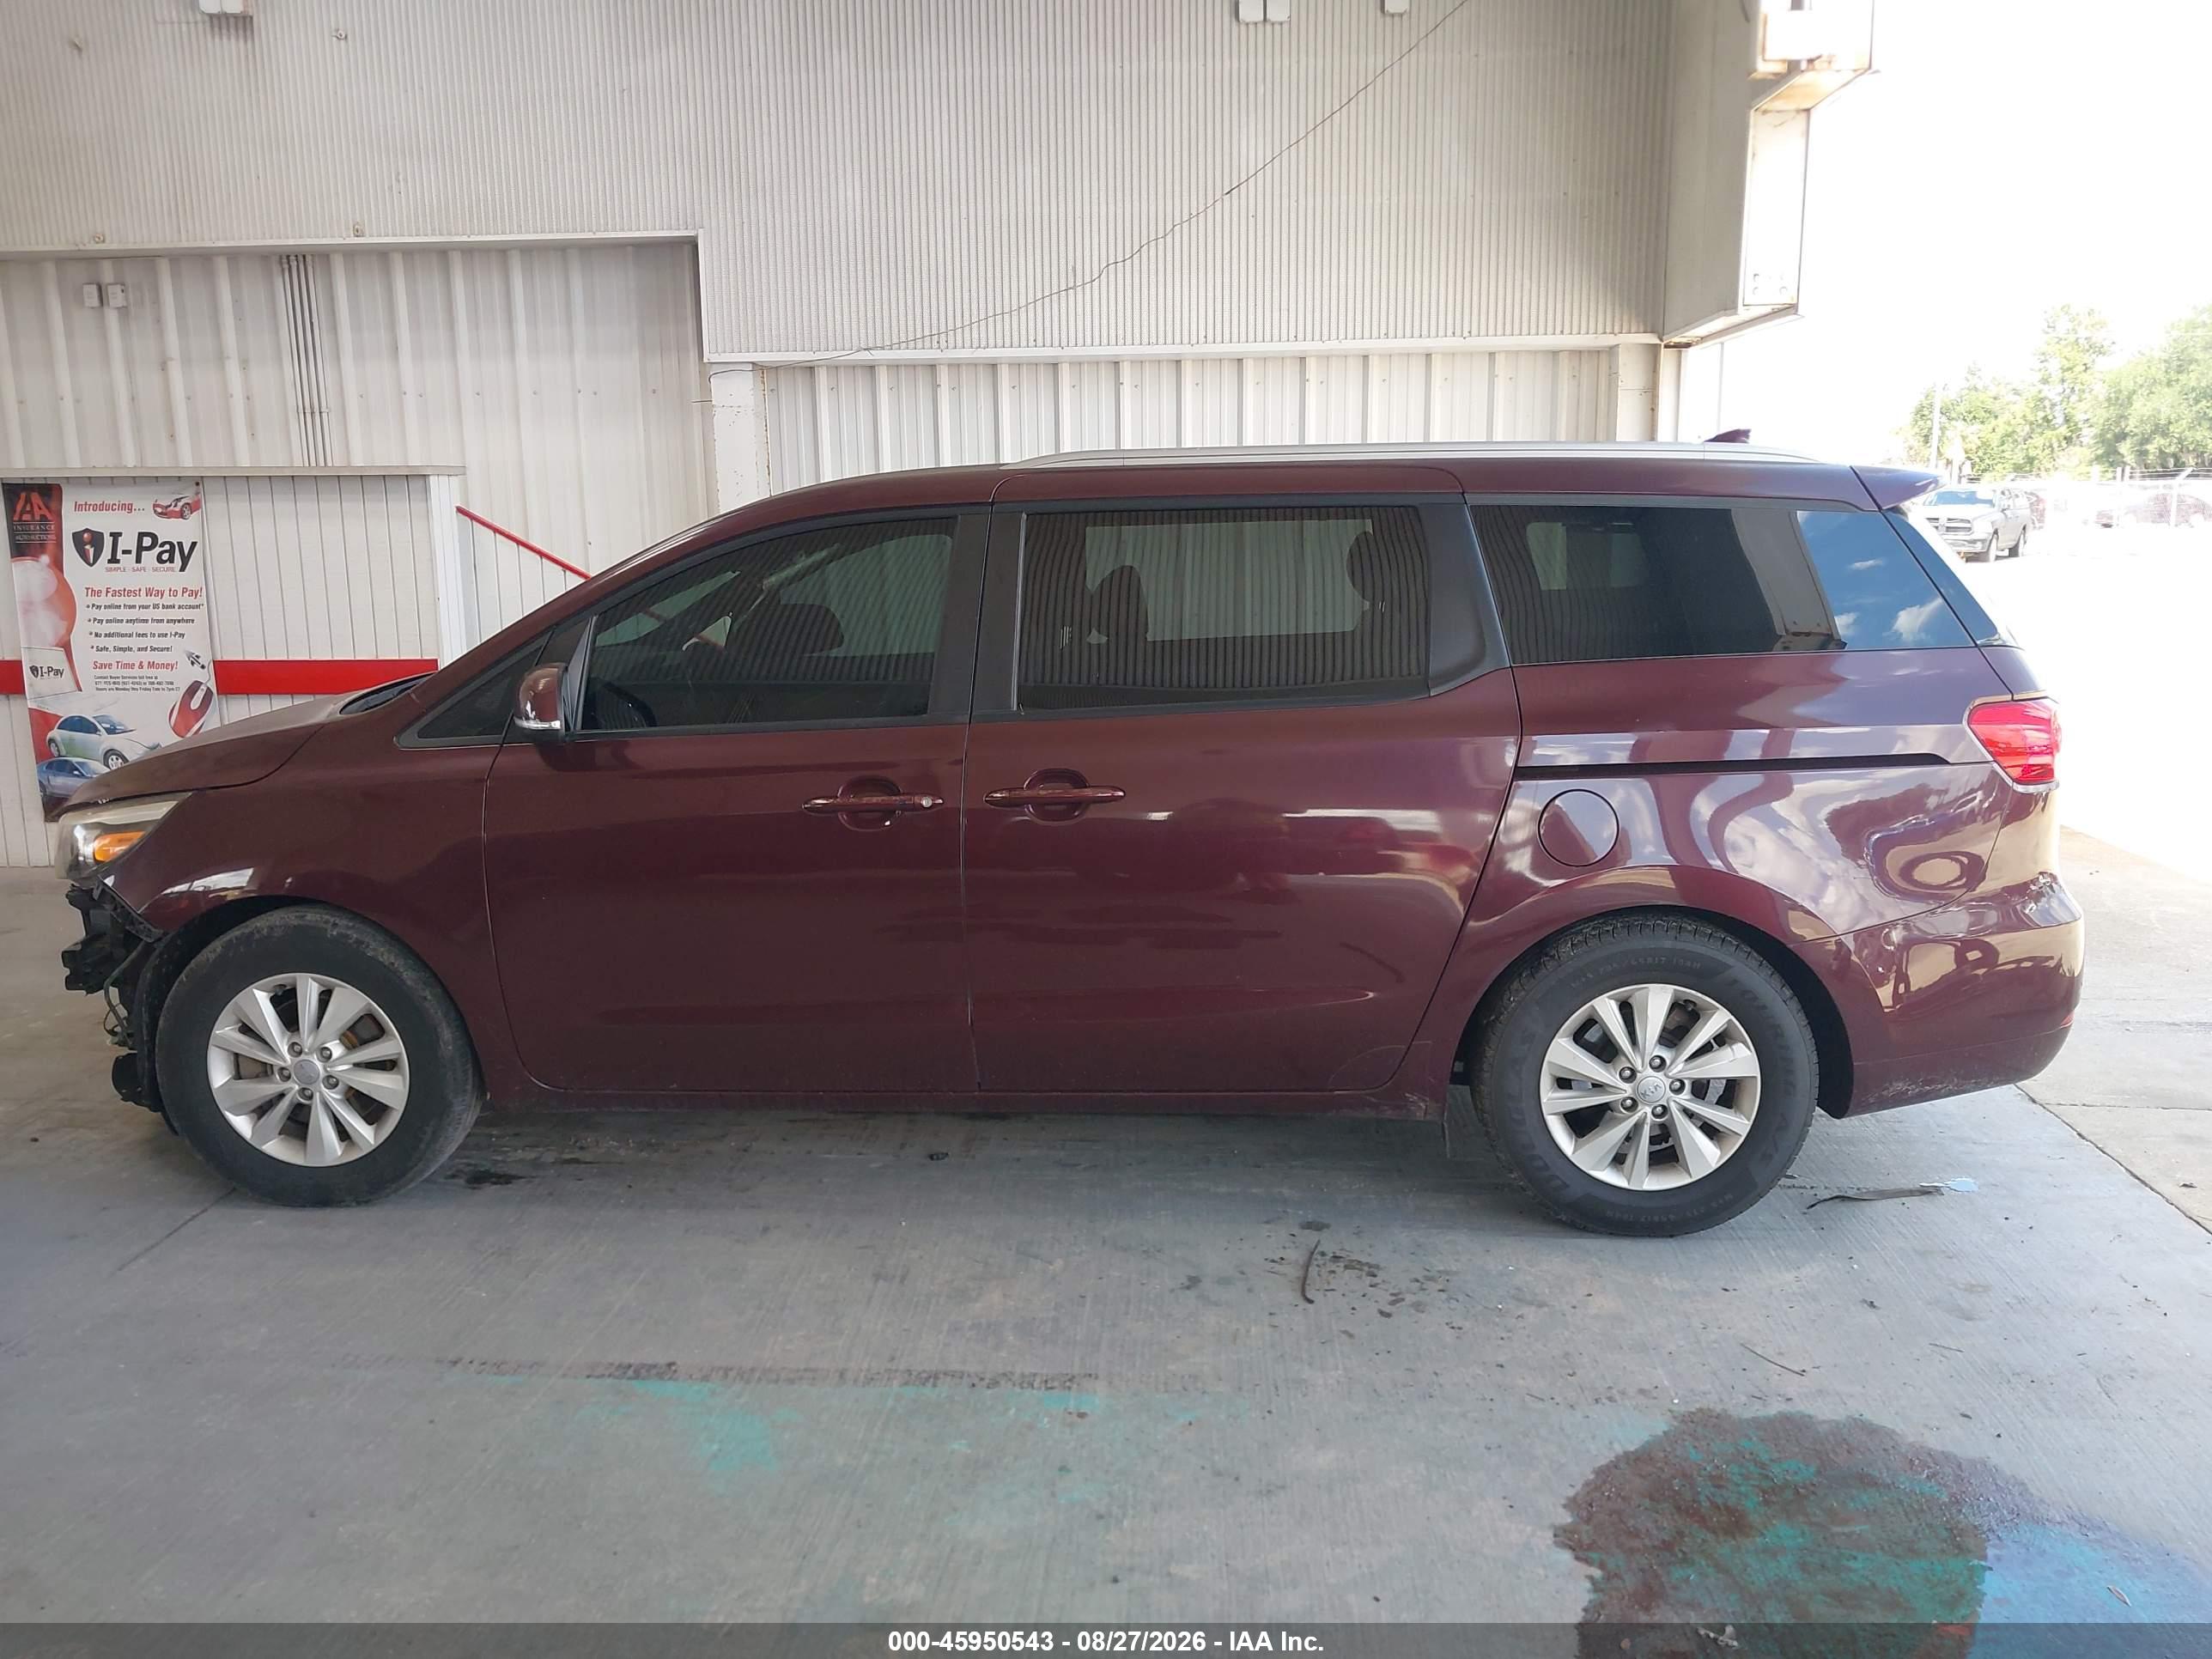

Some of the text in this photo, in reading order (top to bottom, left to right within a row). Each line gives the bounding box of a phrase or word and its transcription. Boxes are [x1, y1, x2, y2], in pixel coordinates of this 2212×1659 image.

[74, 501, 145, 514] Introducing...
[106, 532, 198, 573] I-Pay
[84, 586, 203, 599] The Fastest Way to Pay!
[40, 665, 64, 678] I-Pay
[93, 660, 179, 672] Save Time & Money!
